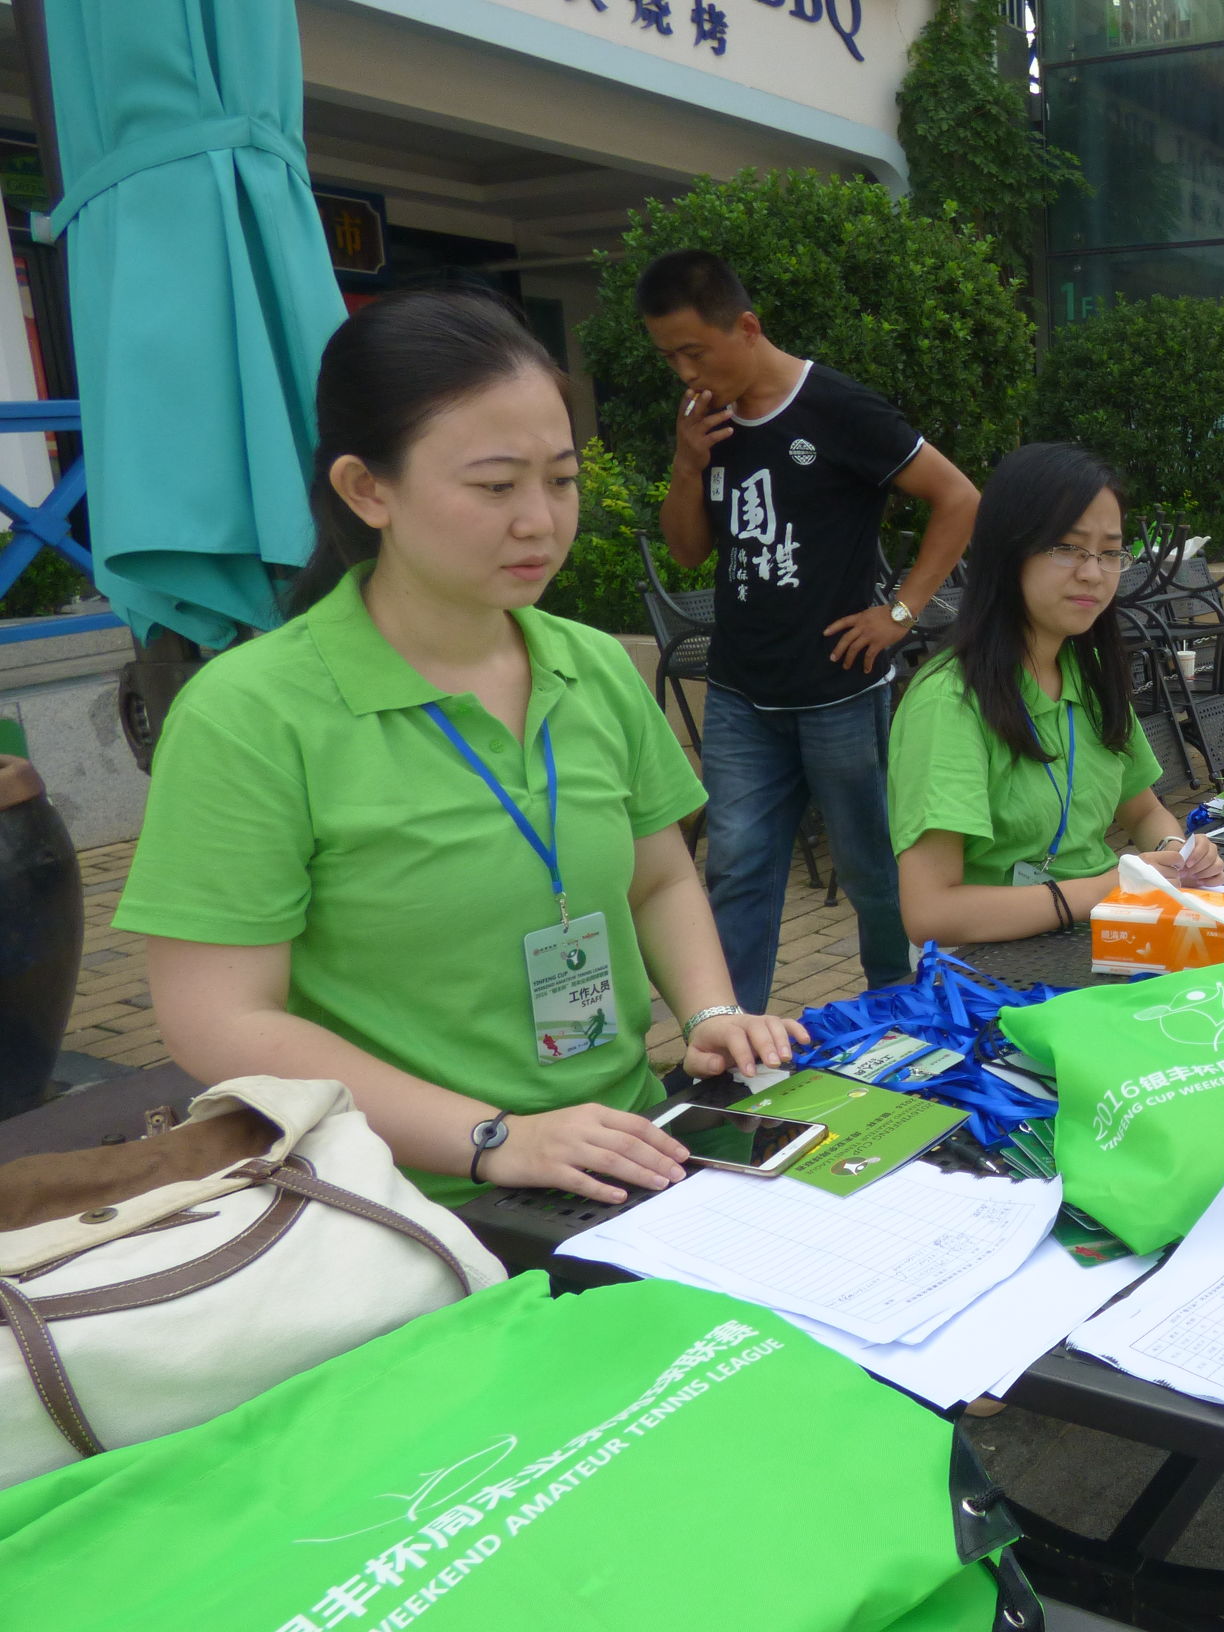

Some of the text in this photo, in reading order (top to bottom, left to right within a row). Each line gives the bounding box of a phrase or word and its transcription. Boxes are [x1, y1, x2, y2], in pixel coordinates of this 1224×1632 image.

[569, 979, 610, 1004] 工作人员
[581, 994, 603, 1008] STAFF
[1099, 1102, 1143, 1152] YINFENG
[1145, 1090, 1176, 1107] CUP
[505, 1438, 631, 1536] AMATEUR
[624, 1379, 710, 1437] TENNIS
[706, 1337, 785, 1382] LEAGUE
